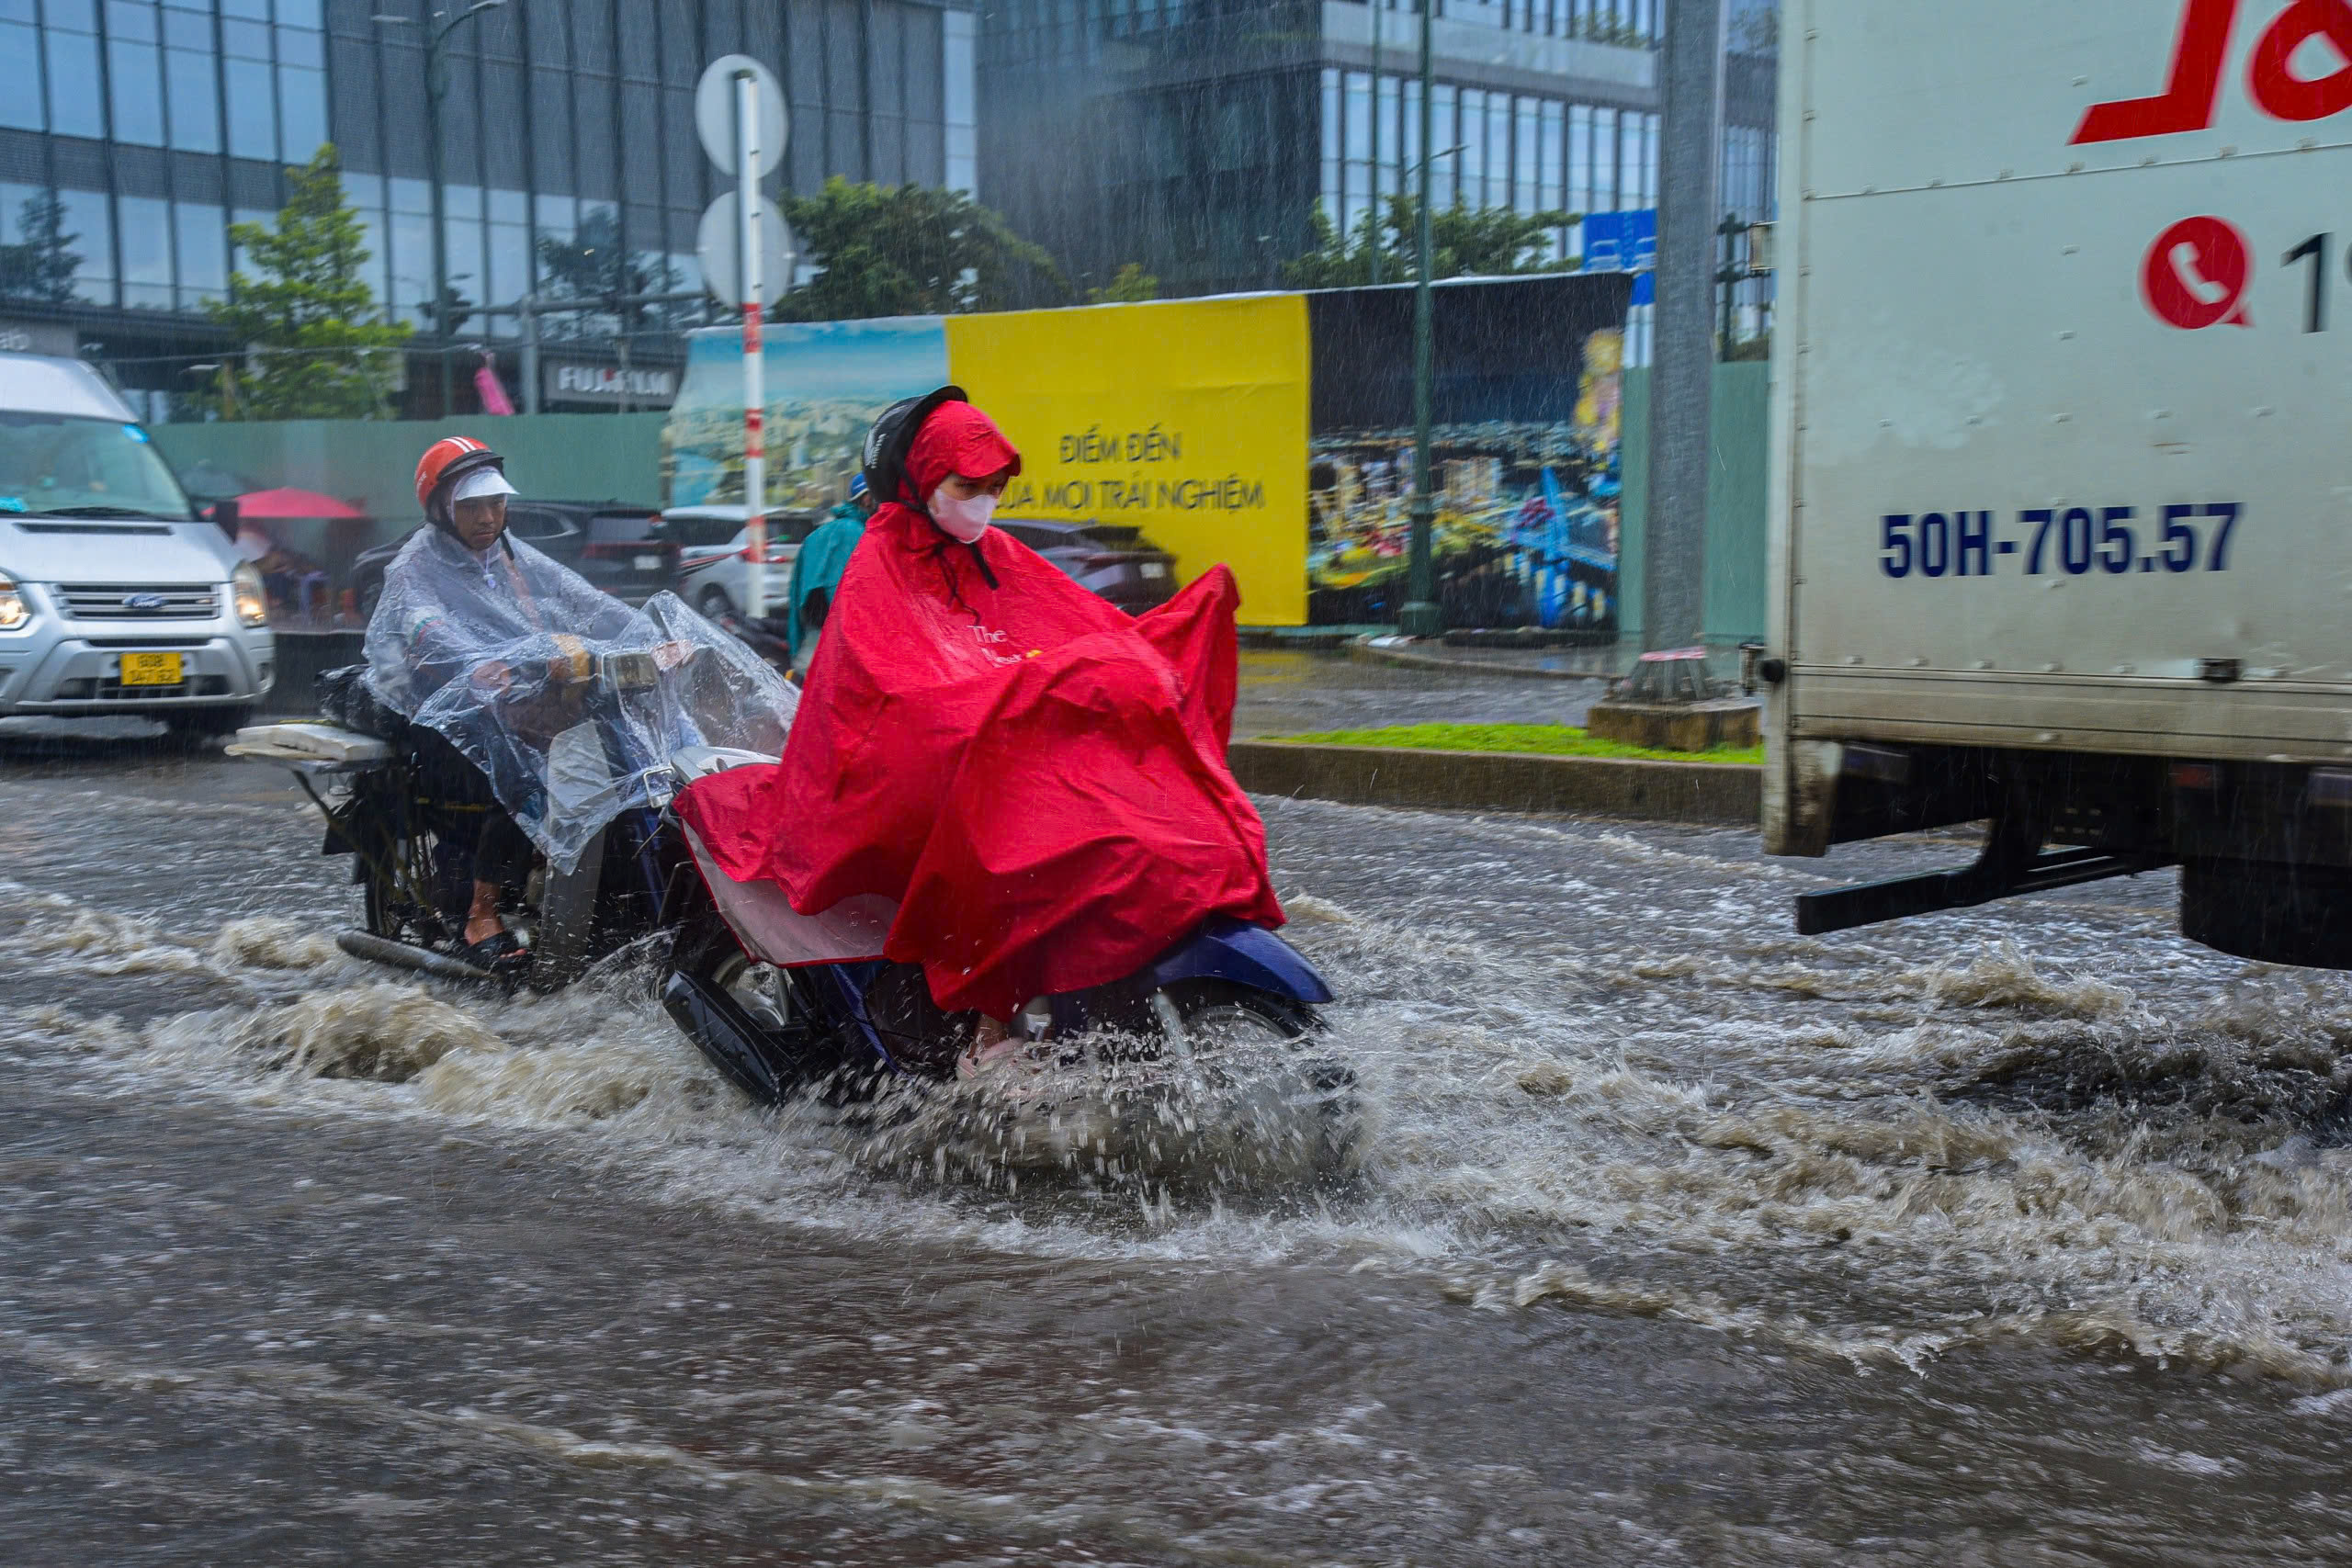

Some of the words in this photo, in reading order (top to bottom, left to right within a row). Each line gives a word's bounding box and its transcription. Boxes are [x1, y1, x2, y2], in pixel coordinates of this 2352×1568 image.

[2278, 231, 2352, 333] 1
[1880, 502, 2245, 579] 50H-705.57
[966, 625, 1008, 643] The
